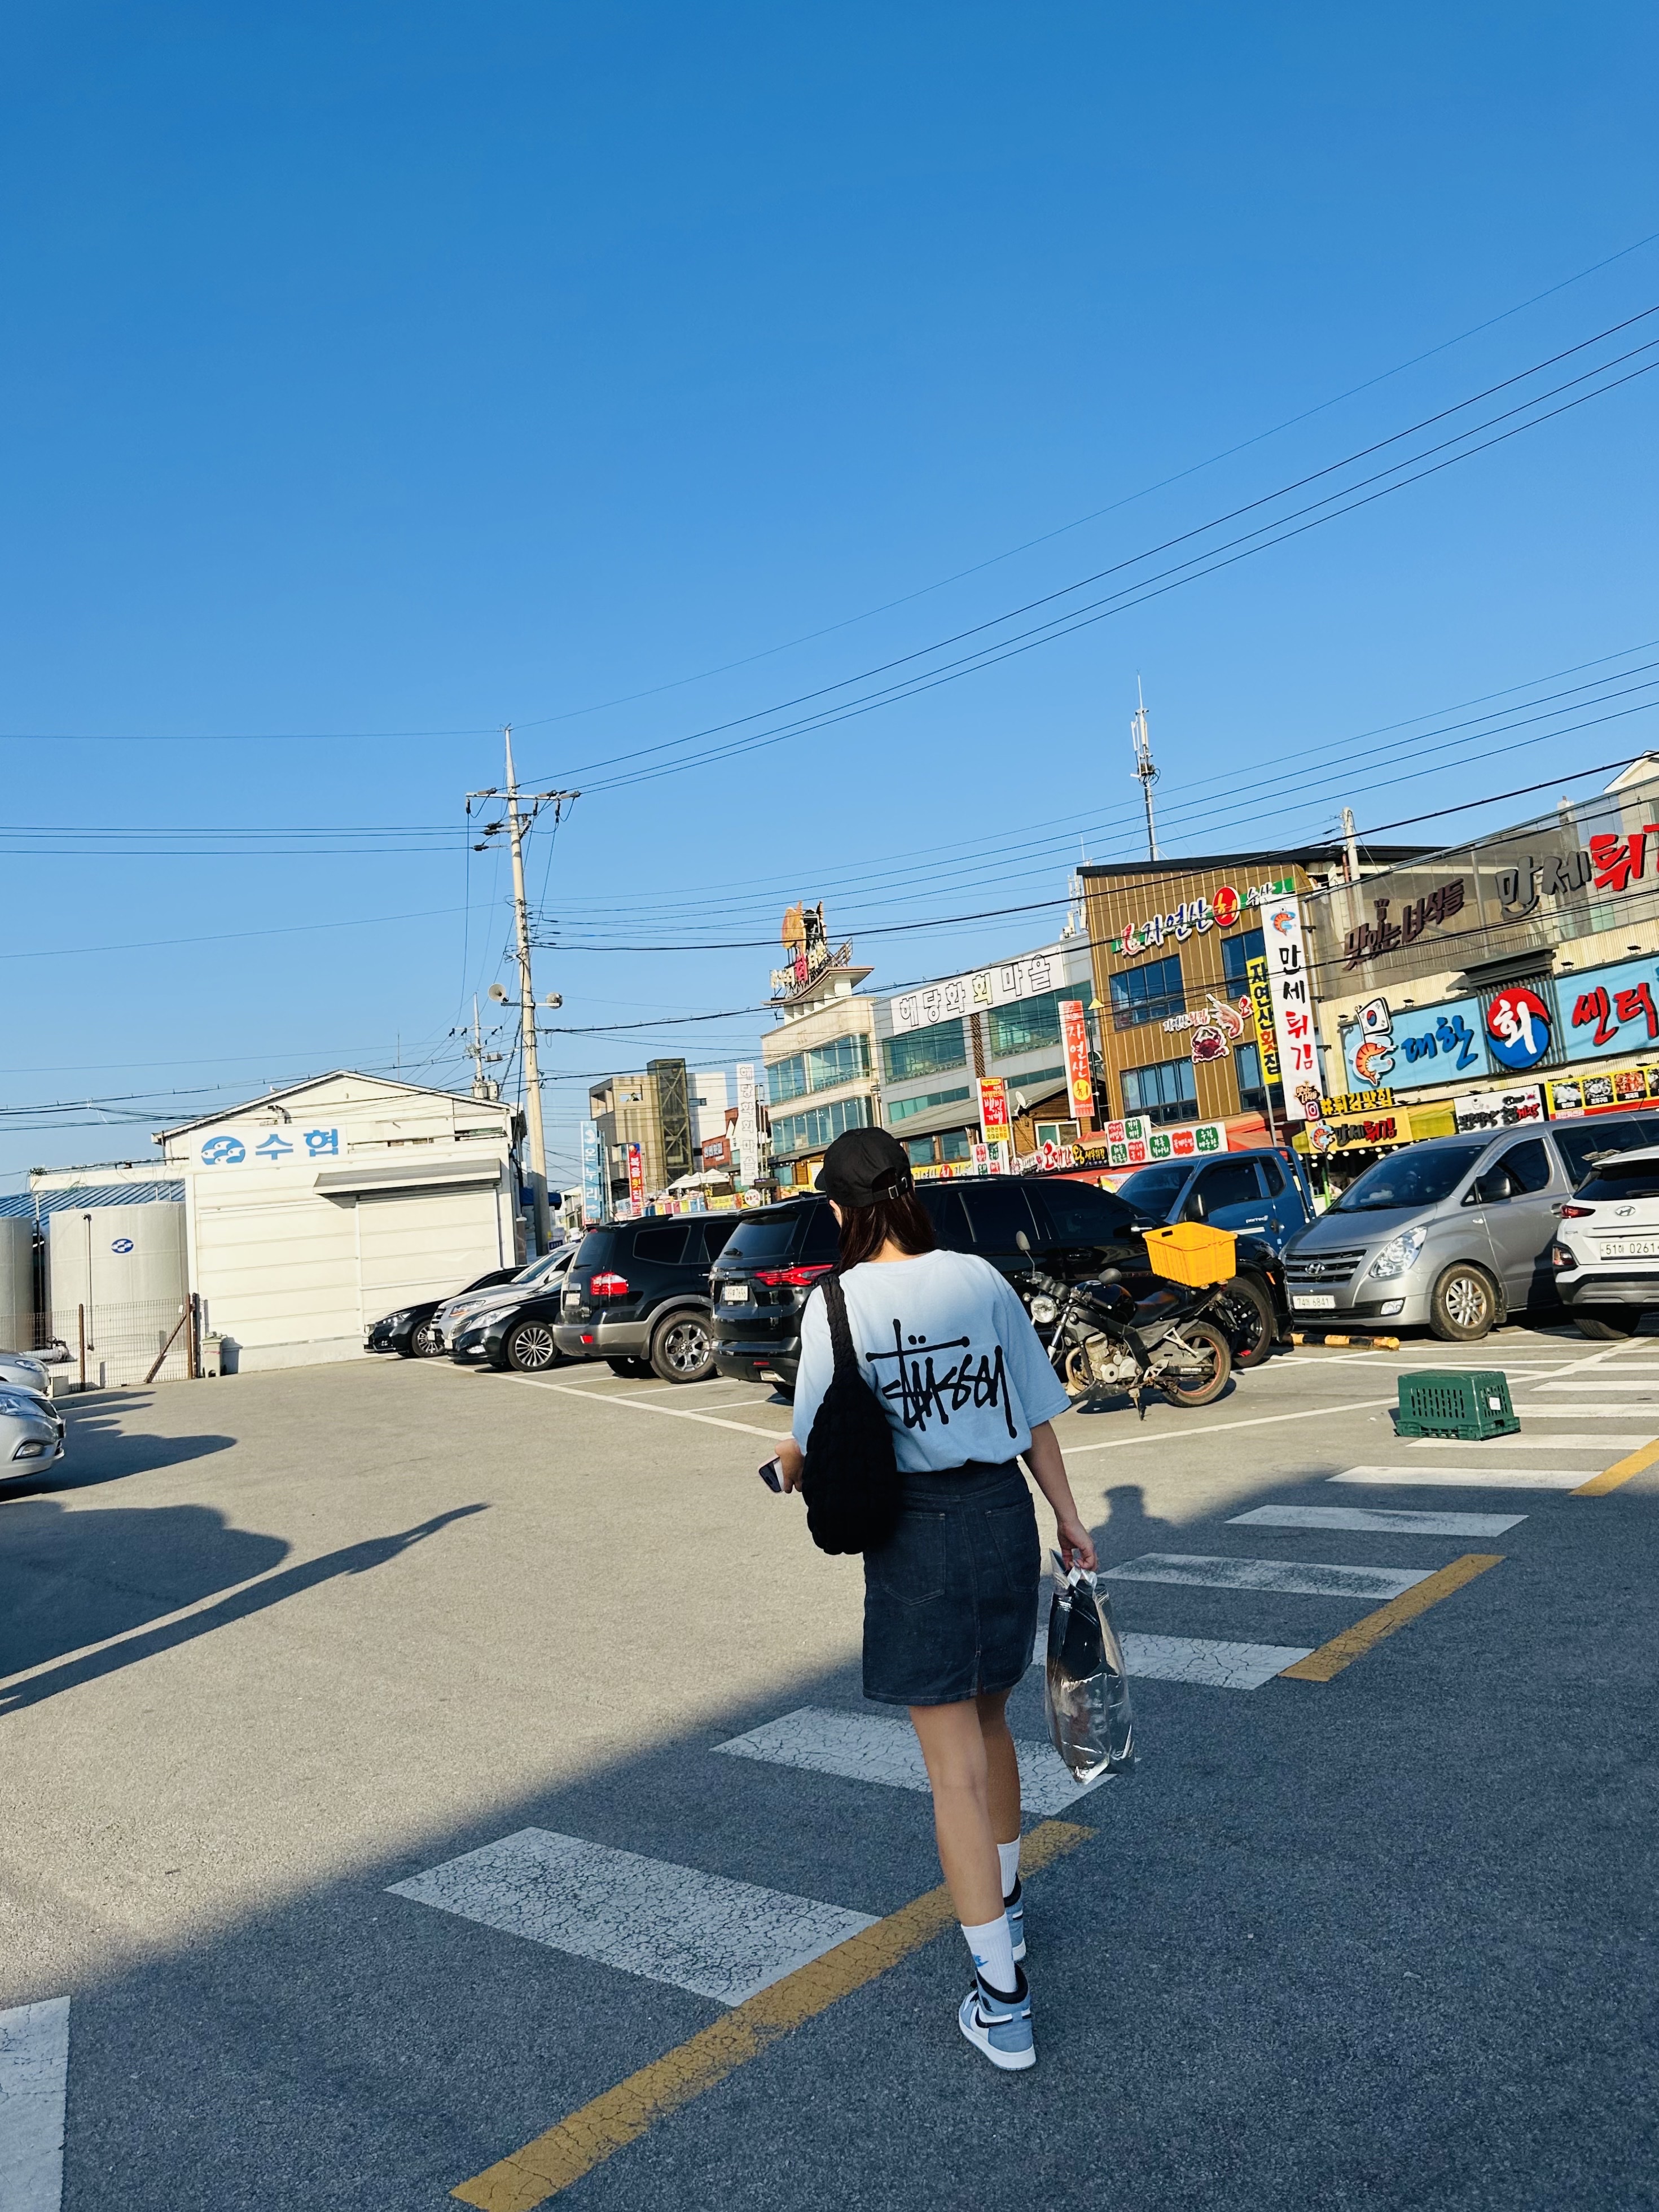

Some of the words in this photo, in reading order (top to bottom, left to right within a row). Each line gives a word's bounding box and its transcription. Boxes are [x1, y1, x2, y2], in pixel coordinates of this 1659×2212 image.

[1495, 823, 1659, 920] 만세튀
[1141, 897, 1213, 946] 자연산
[1214, 893, 1237, 919] 회
[1342, 899, 1402, 971] 맛있는
[1402, 878, 1465, 943] 녀석들
[1279, 944, 1313, 1070] 만세튀김
[1066, 1022, 1087, 1078] 자연산
[1401, 1015, 1478, 1070] 대한
[1493, 999, 1537, 1055] 회
[1076, 1082, 1089, 1098] 회
[1320, 1087, 1393, 1116] #튀김맛집
[256, 1128, 339, 1161] 수협
[1333, 1117, 1397, 1147] 만세튀김
[584, 1147, 599, 1201] 온누리
[1630, 1243, 1654, 1254] 0261
[1313, 1297, 1329, 1307] 6841
